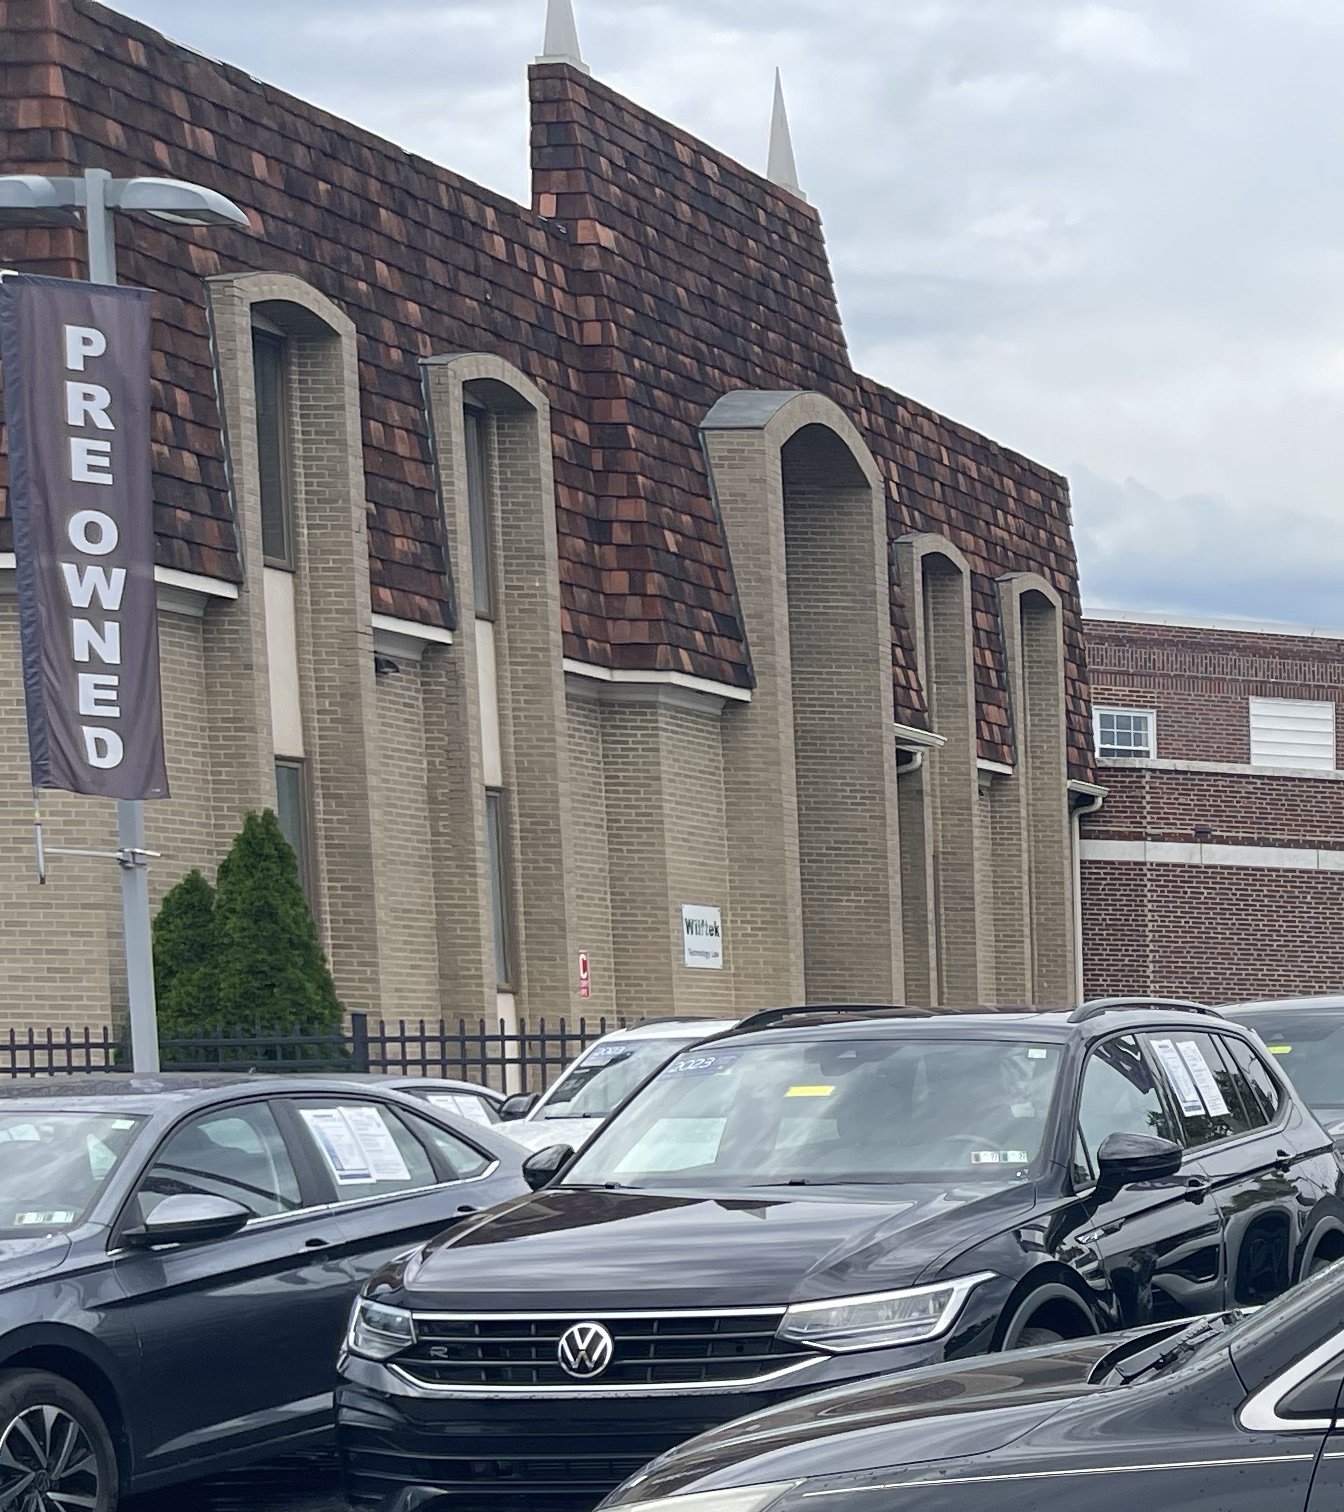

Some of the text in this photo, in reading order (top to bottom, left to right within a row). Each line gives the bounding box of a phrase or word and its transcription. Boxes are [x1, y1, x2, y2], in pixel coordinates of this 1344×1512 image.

[60, 324, 127, 770] PRE OWNED
[667, 1056, 717, 1073] 2023
